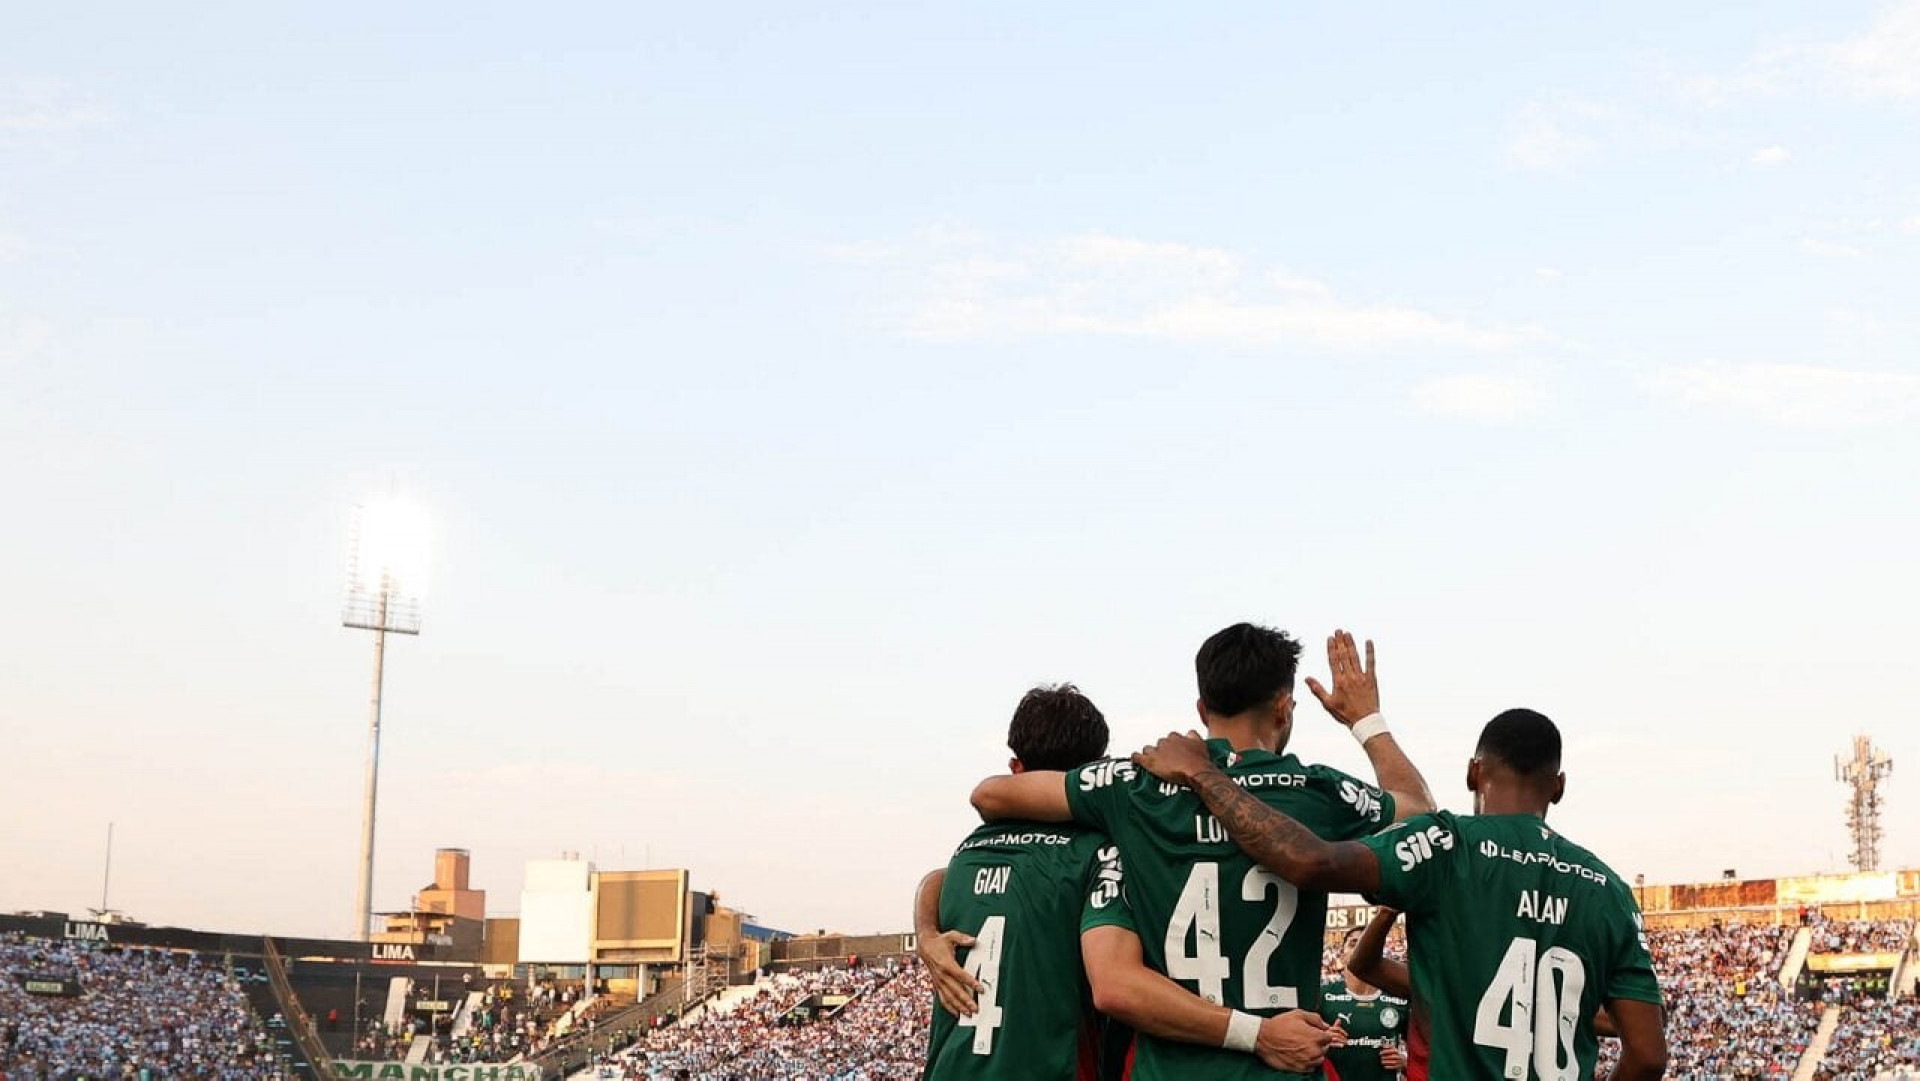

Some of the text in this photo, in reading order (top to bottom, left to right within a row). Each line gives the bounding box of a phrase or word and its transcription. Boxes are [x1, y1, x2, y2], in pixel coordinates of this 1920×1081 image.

[974, 866, 1011, 895] GIAY
[1517, 890, 1568, 924] ALAN
[64, 921, 109, 941] LIMA
[1164, 862, 1298, 1009] 42
[371, 944, 415, 960] LIMA
[958, 916, 1005, 1055] 4
[1473, 937, 1586, 1081] 40
[334, 1063, 525, 1081] MANCHA
